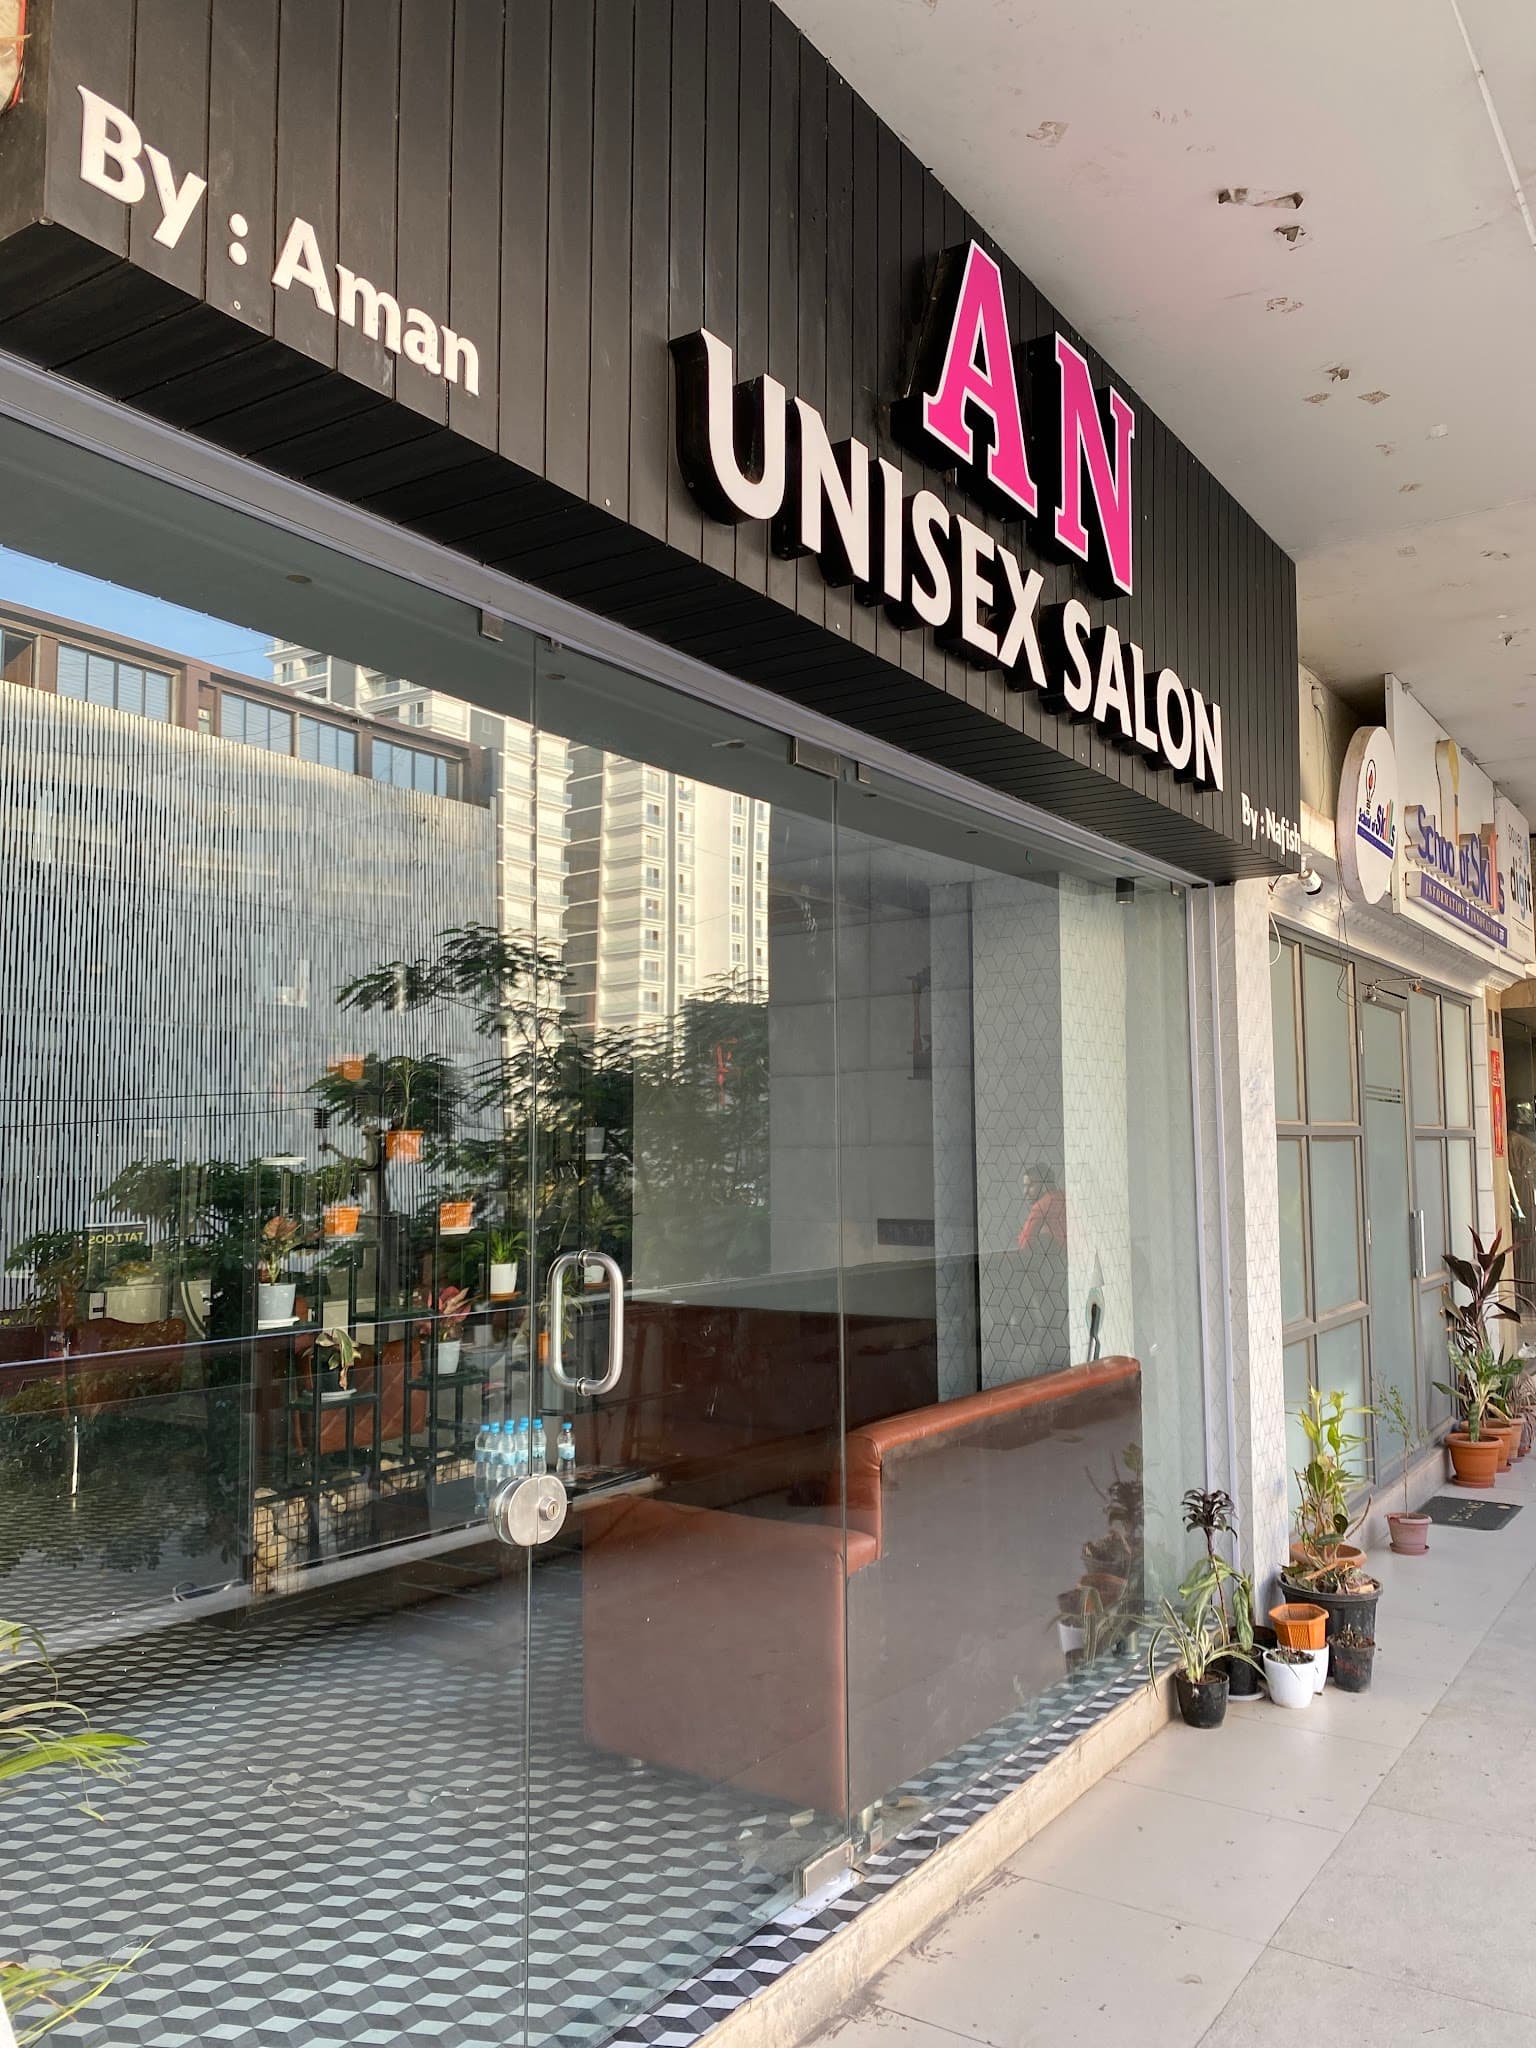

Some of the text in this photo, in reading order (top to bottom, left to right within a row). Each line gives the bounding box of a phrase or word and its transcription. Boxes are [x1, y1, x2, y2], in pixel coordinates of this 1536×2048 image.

[77, 85, 206, 249] By
[271, 217, 480, 396] Aman
[701, 327, 1224, 792] UNISEX SALON
[923, 239, 1135, 597] AN
[1241, 792, 1258, 840] By
[1265, 807, 1301, 855] Nafish
